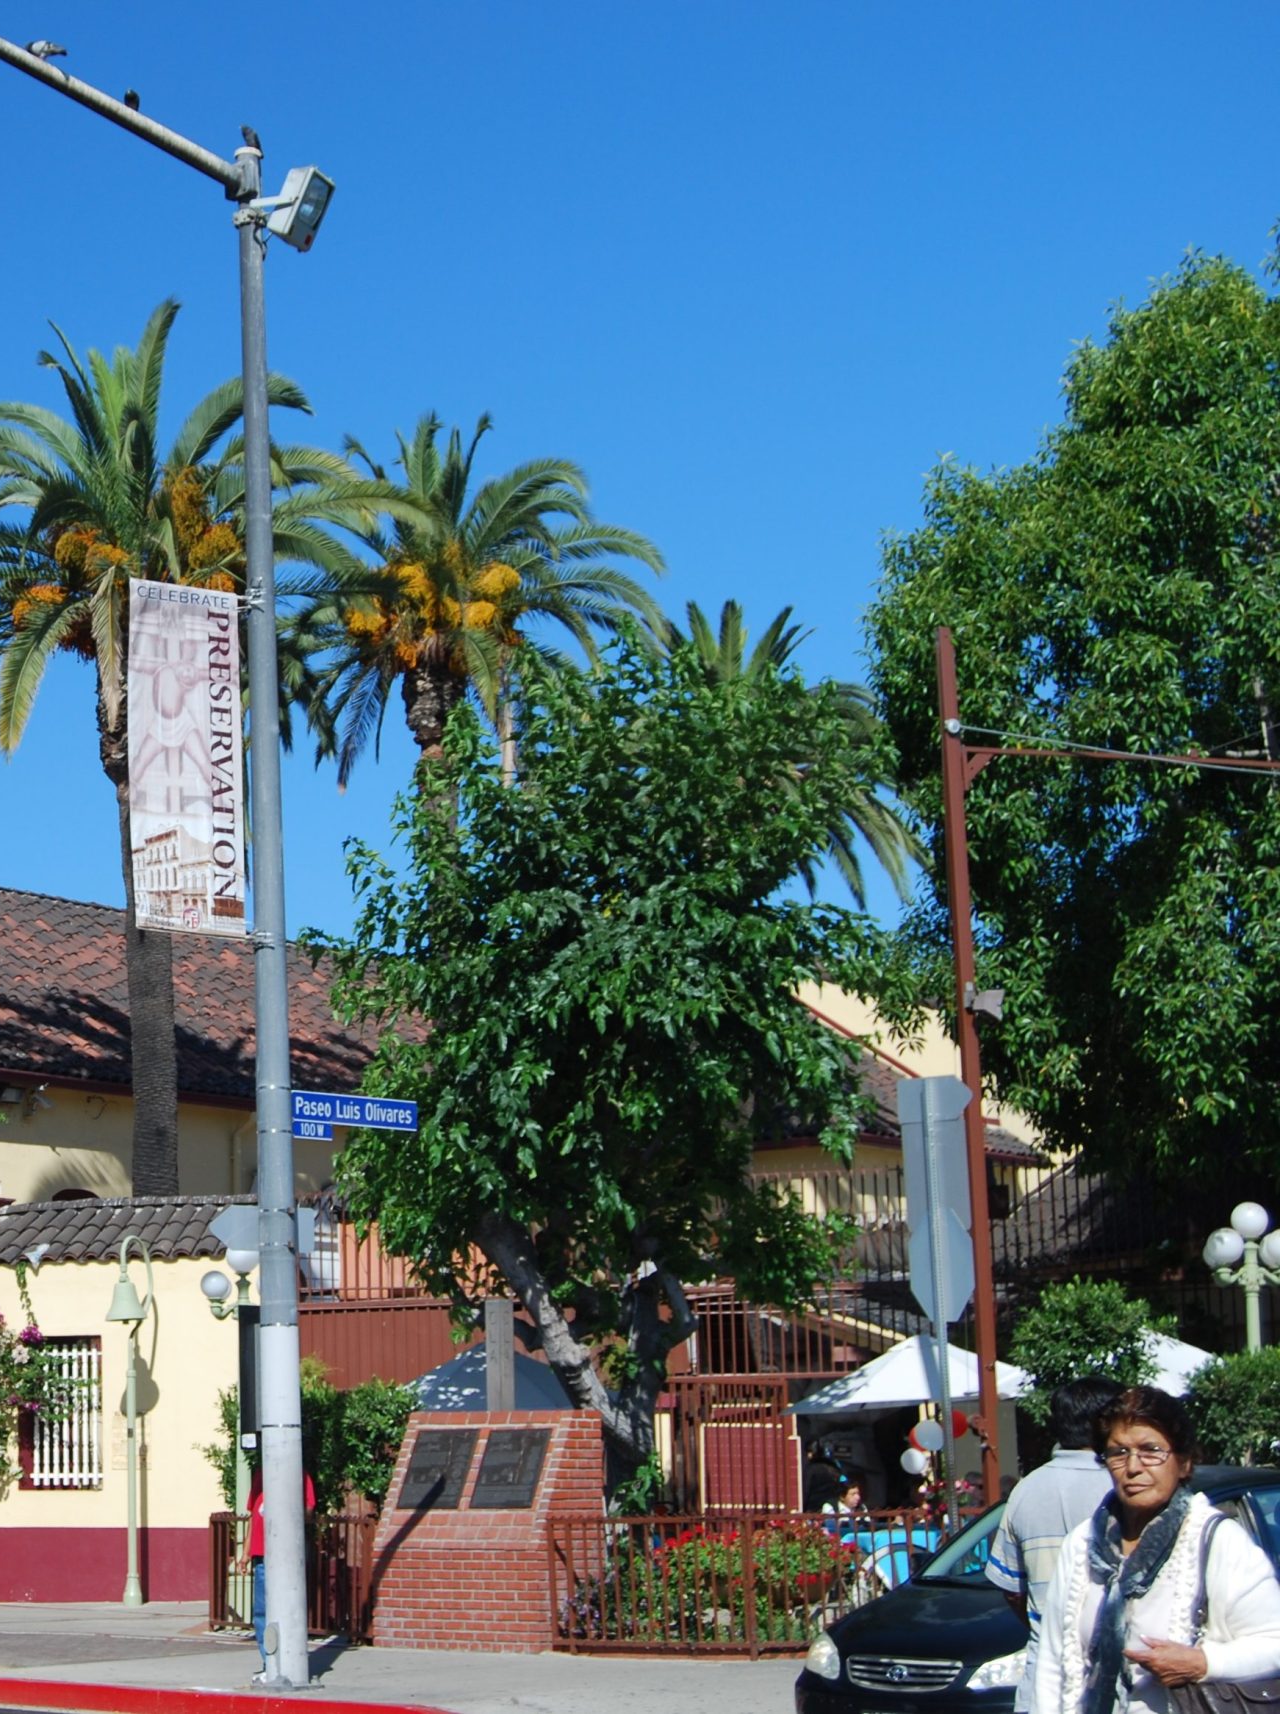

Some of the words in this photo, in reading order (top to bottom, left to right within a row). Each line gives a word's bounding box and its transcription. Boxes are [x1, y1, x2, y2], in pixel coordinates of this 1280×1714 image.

[137, 585, 230, 609] CELEBRATE
[207, 608, 237, 901] PRESERVATION
[295, 1096, 331, 1118] Paseo
[336, 1099, 361, 1120] Luis
[365, 1102, 412, 1125] Olivares
[301, 1122, 316, 1136] 100
[317, 1124, 325, 1137] W
